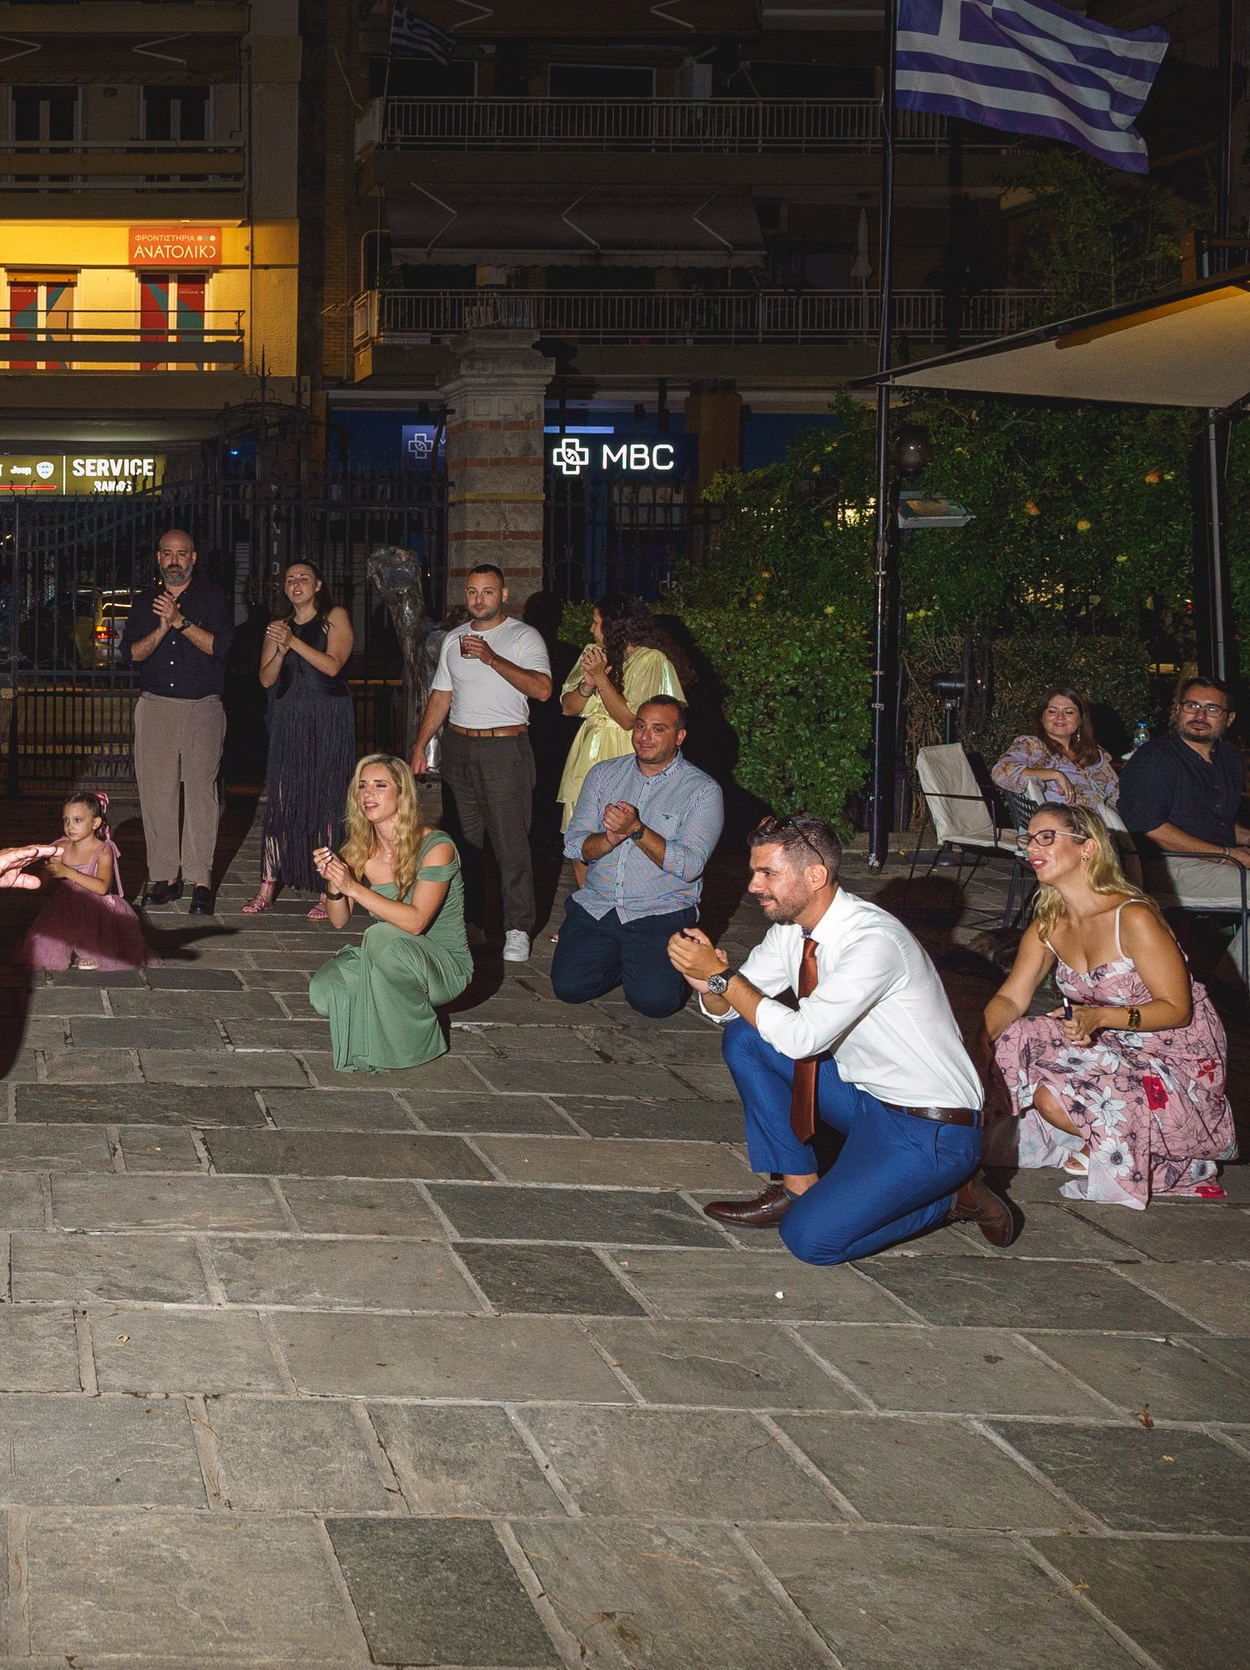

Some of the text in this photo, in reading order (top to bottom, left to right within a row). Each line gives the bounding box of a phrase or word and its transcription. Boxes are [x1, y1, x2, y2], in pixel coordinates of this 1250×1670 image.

[135, 234, 195, 242] ΦΡΟΝΤΙΣΤΗΡΙΑ
[133, 244, 216, 259] ΑΝΑΤΟΛΙΚΟ
[602, 443, 674, 470] MBC
[72, 458, 154, 477] SERVICE
